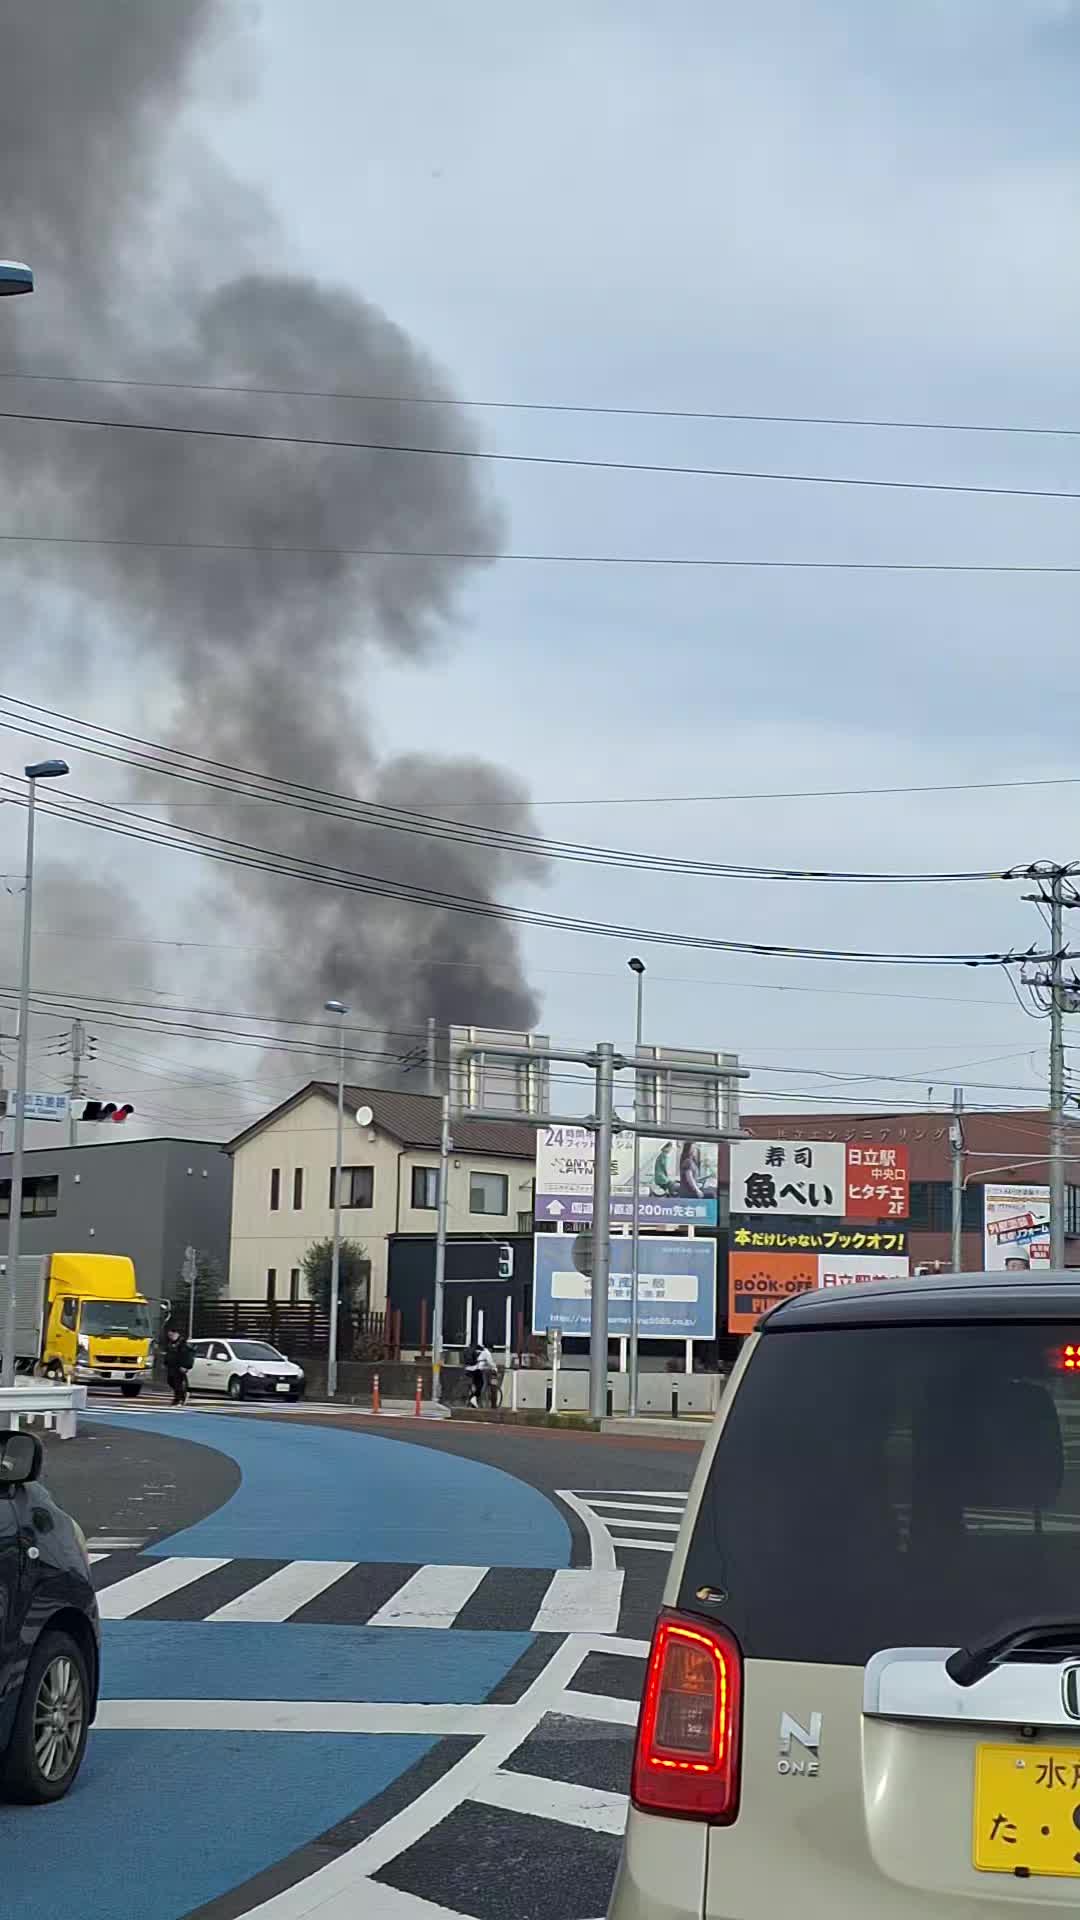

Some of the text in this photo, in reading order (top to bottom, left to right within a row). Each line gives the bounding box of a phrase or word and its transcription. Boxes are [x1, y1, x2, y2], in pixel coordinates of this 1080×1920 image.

[765, 1146, 813, 1168] 寿司
[848, 1149, 896, 1166] 日立駅
[872, 1168, 905, 1181] 中央口
[744, 1172, 833, 1209] 魚べい
[888, 1201, 905, 1215] 2F
[823, 1273, 900, 1289] 日立駅
[777, 1711, 824, 1757] N
[778, 1760, 820, 1778] ONE
